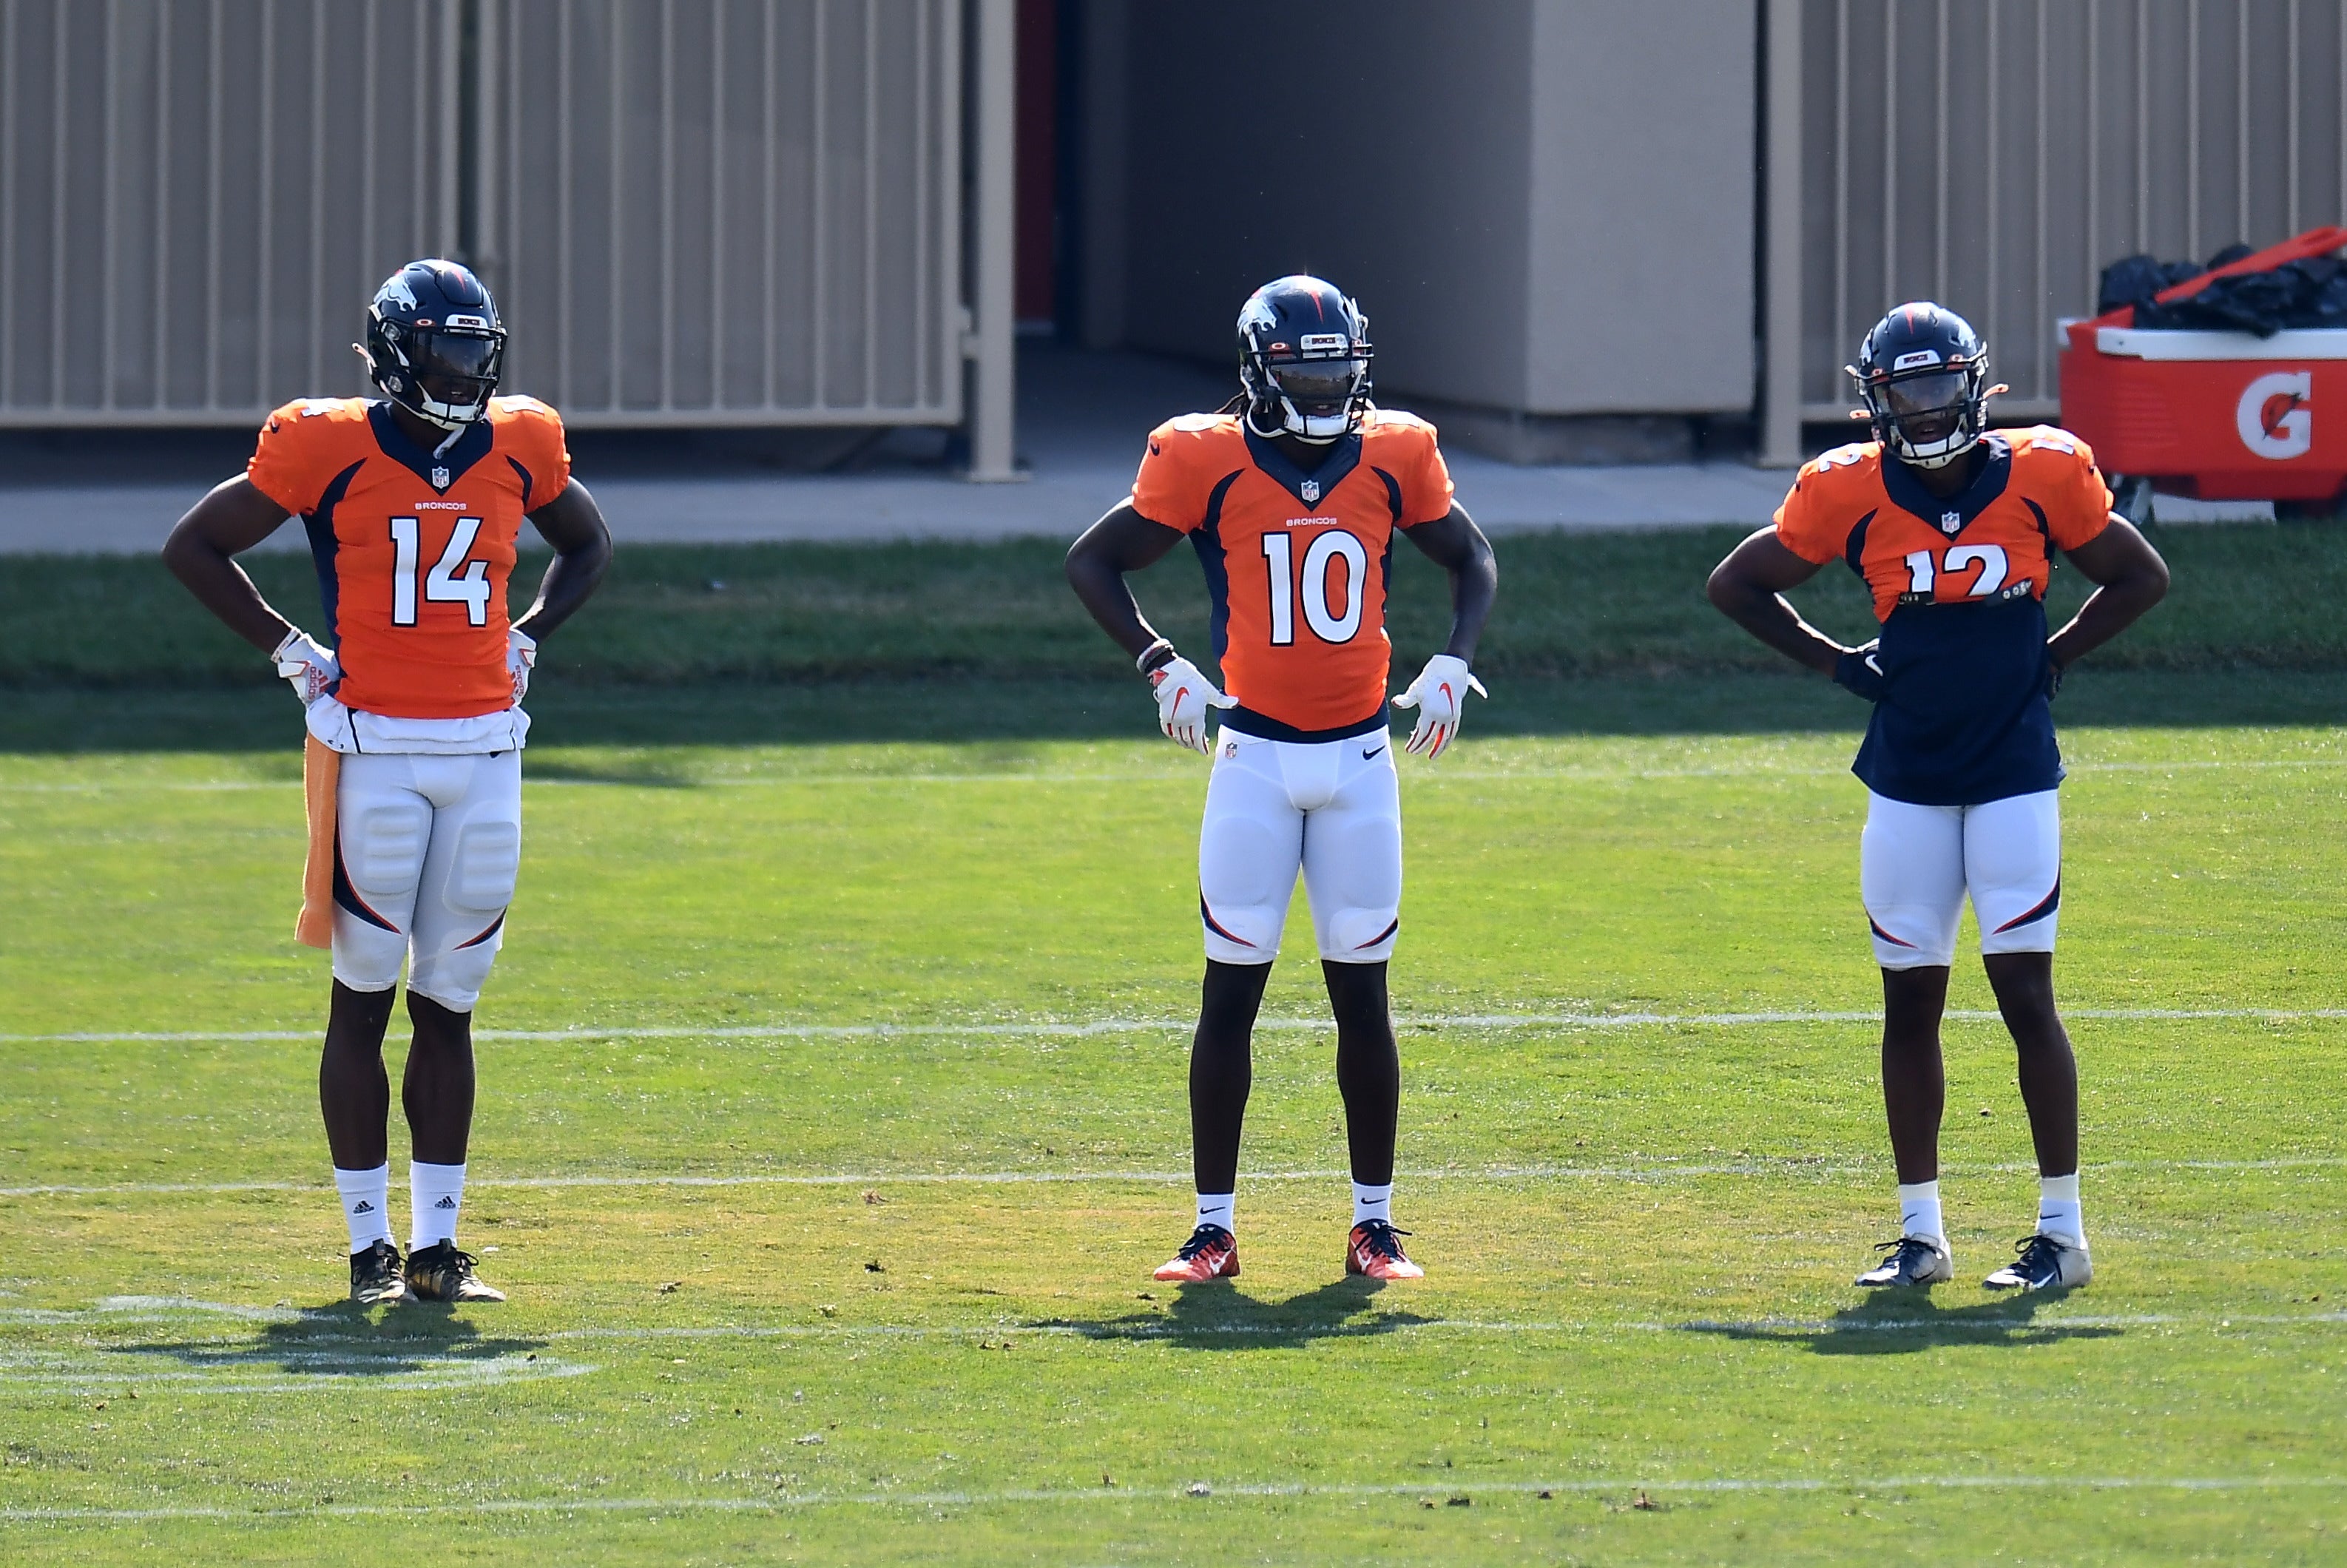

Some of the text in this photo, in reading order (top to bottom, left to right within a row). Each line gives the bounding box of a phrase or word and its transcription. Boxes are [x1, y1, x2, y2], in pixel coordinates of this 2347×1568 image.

[2236, 371, 2311, 460] G
[415, 501, 467, 510] BRONCOS
[1286, 517, 1337, 527] BRONCOS
[389, 516, 492, 627] 14
[1261, 528, 1368, 646] 10
[1904, 544, 2008, 597] 12
[308, 666, 319, 700] adidas
